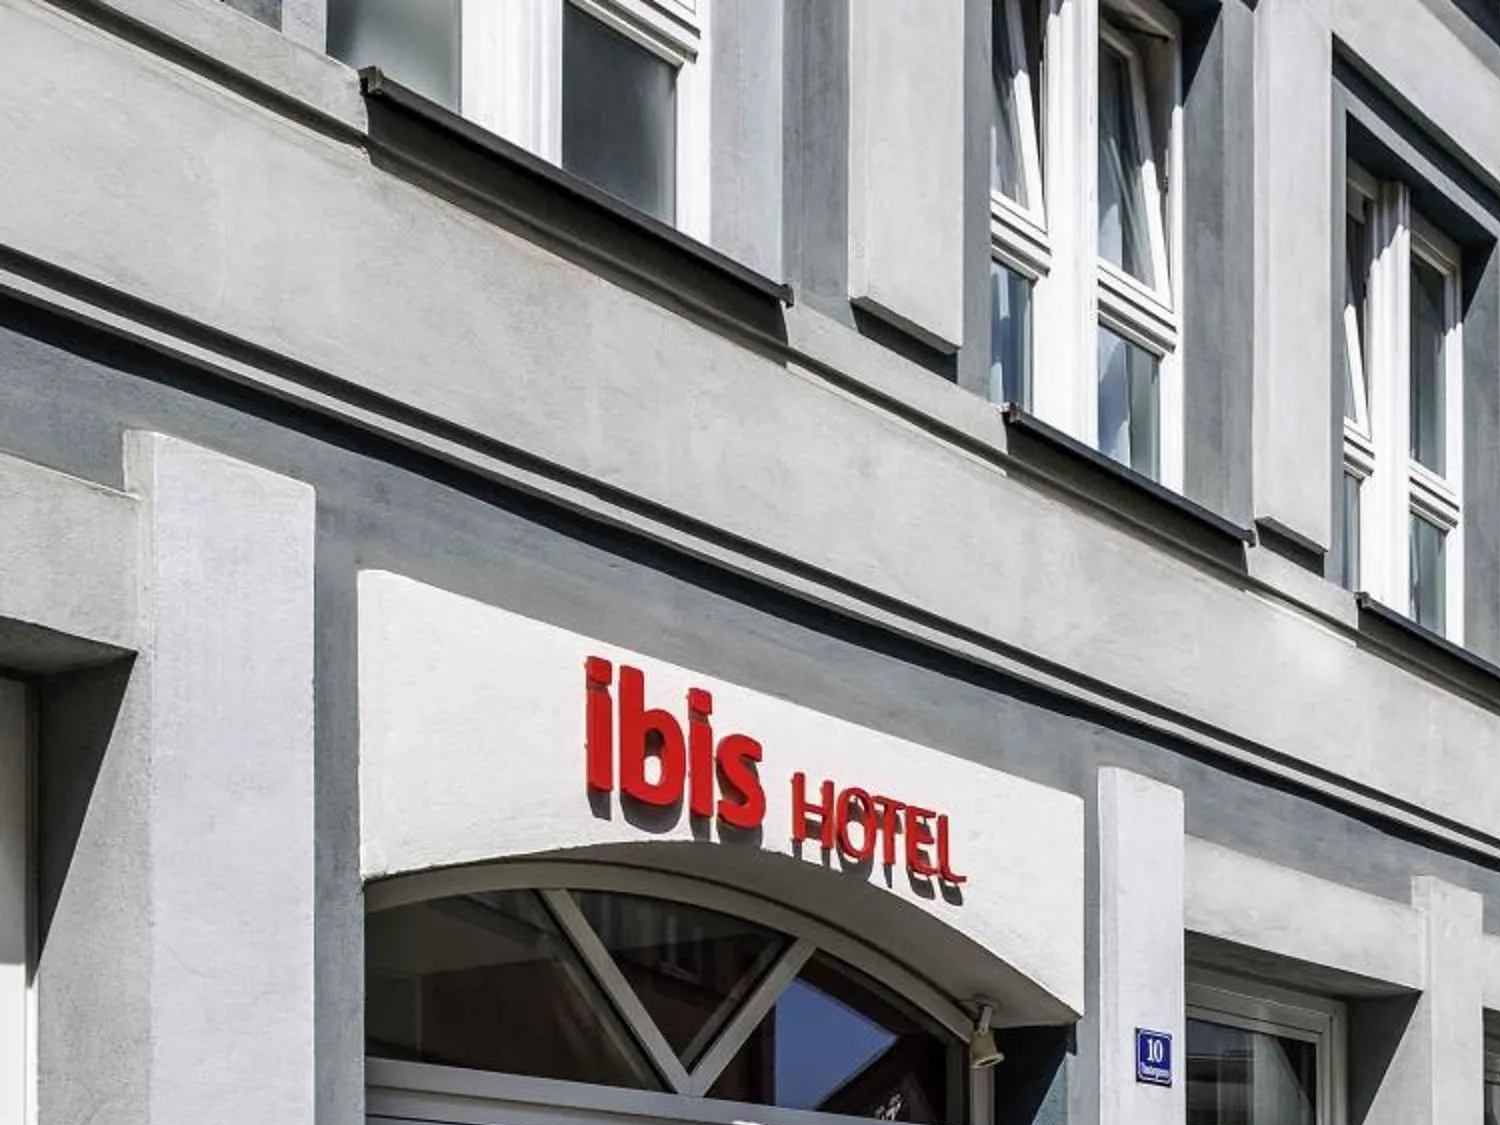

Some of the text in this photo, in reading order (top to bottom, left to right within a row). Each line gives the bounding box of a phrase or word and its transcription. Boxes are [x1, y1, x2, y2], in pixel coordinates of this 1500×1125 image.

[584, 656, 967, 883] ibis HOTEL
[1146, 1038, 1163, 1063] 10
